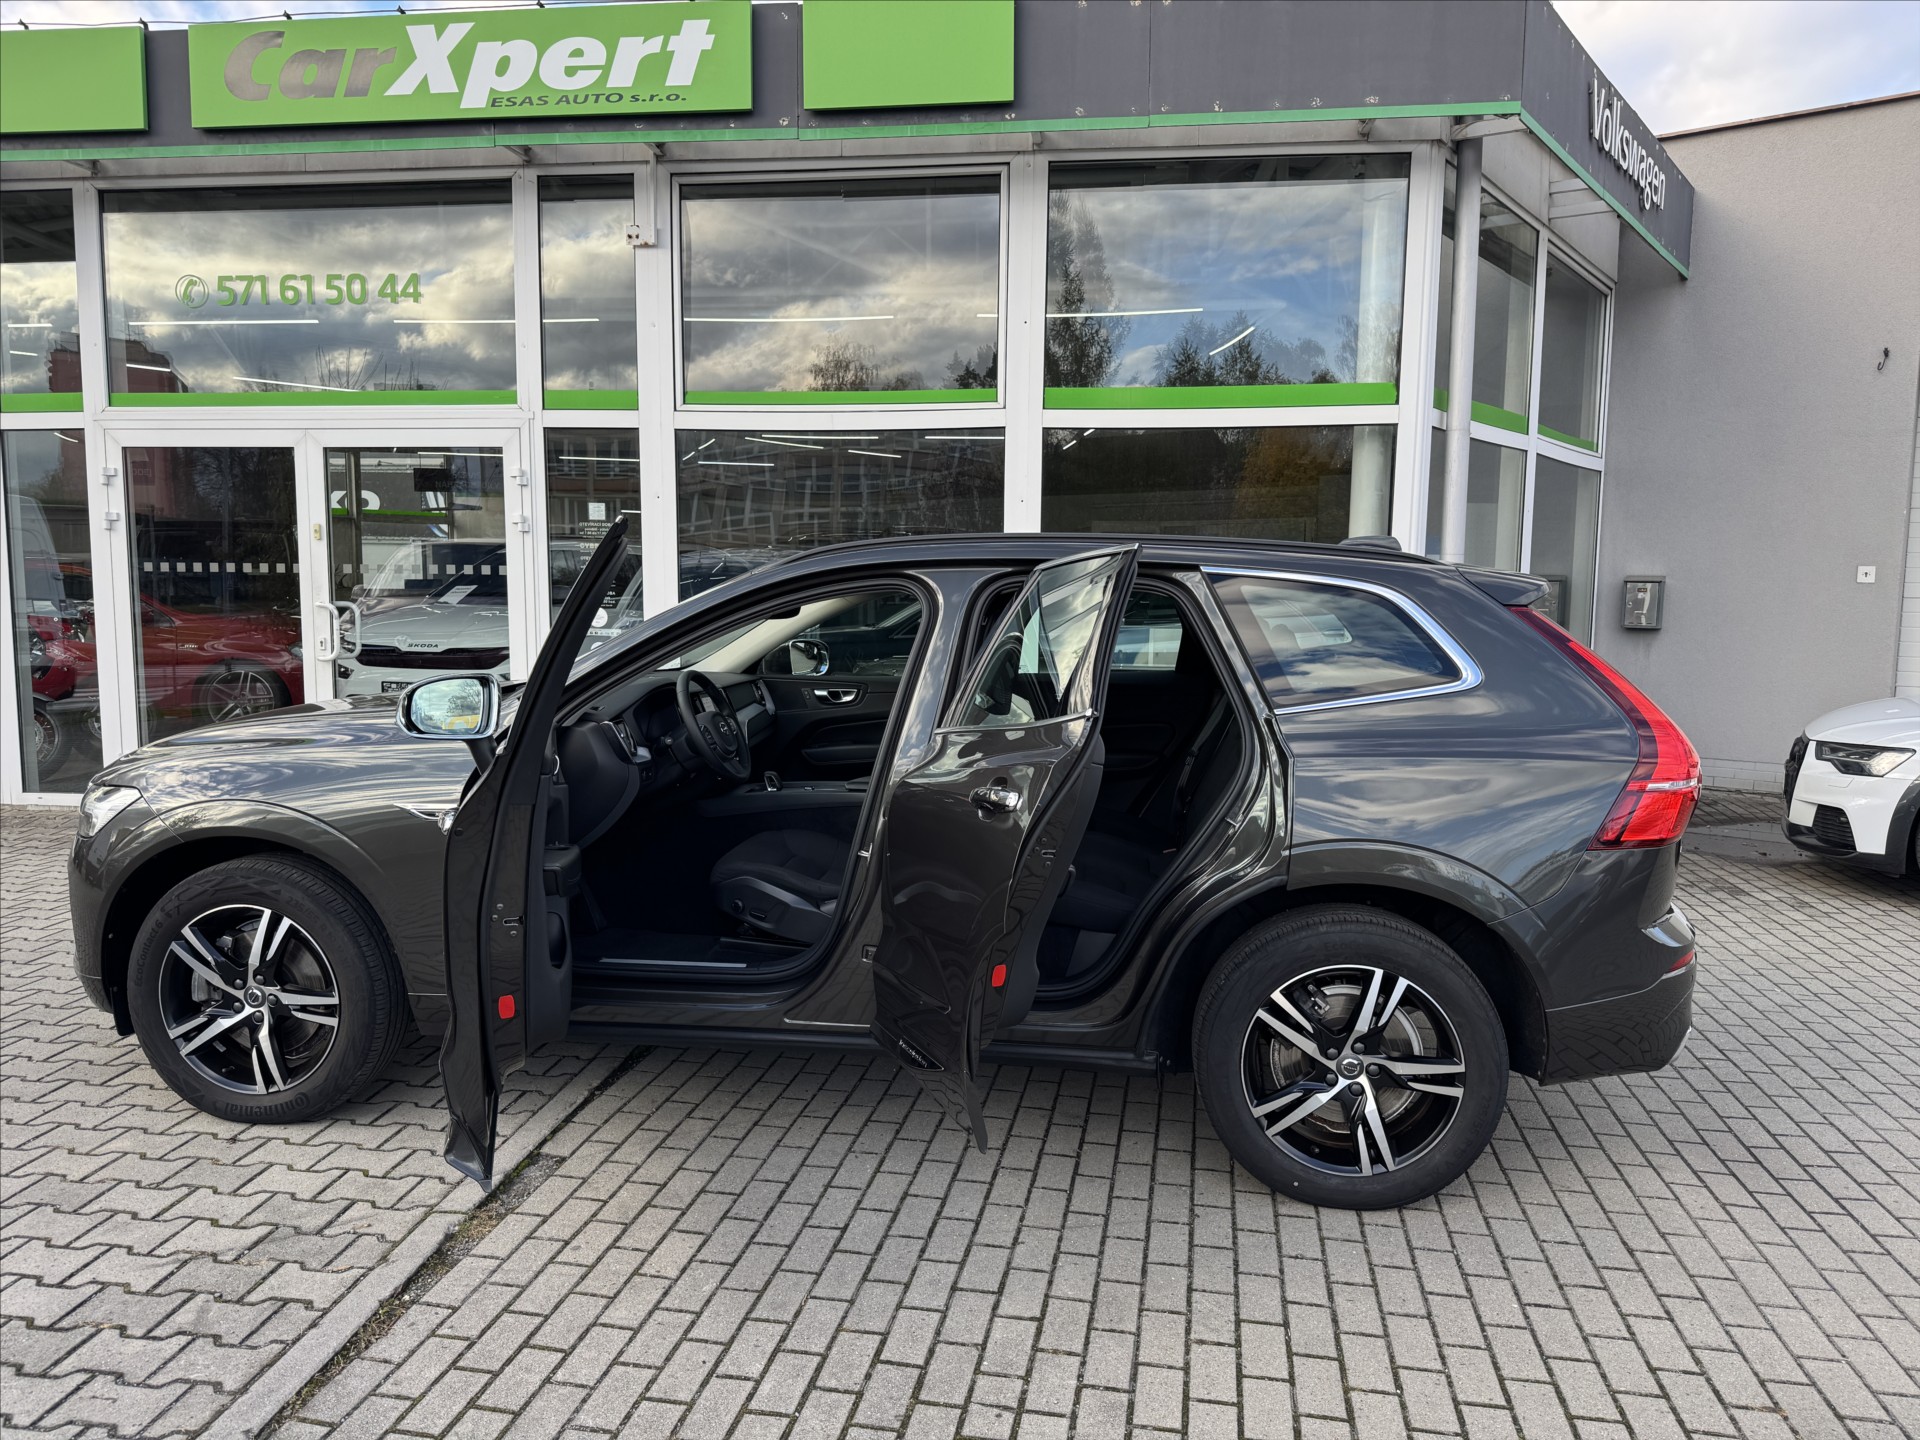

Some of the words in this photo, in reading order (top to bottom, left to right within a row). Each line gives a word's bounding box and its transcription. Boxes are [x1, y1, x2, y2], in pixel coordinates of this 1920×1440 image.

[490, 95, 549, 107] ESAS
[554, 92, 624, 106] AUTO
[629, 92, 687, 103] s.r.o.
[1593, 78, 1666, 210] Volkswagen
[216, 275, 269, 306] 571
[279, 274, 314, 305] 61
[325, 273, 368, 305] 50
[378, 273, 422, 304] 44
[134, 928, 159, 987] EcoContact
[155, 919, 164, 929] 6
[224, 1092, 310, 1117] Continental
